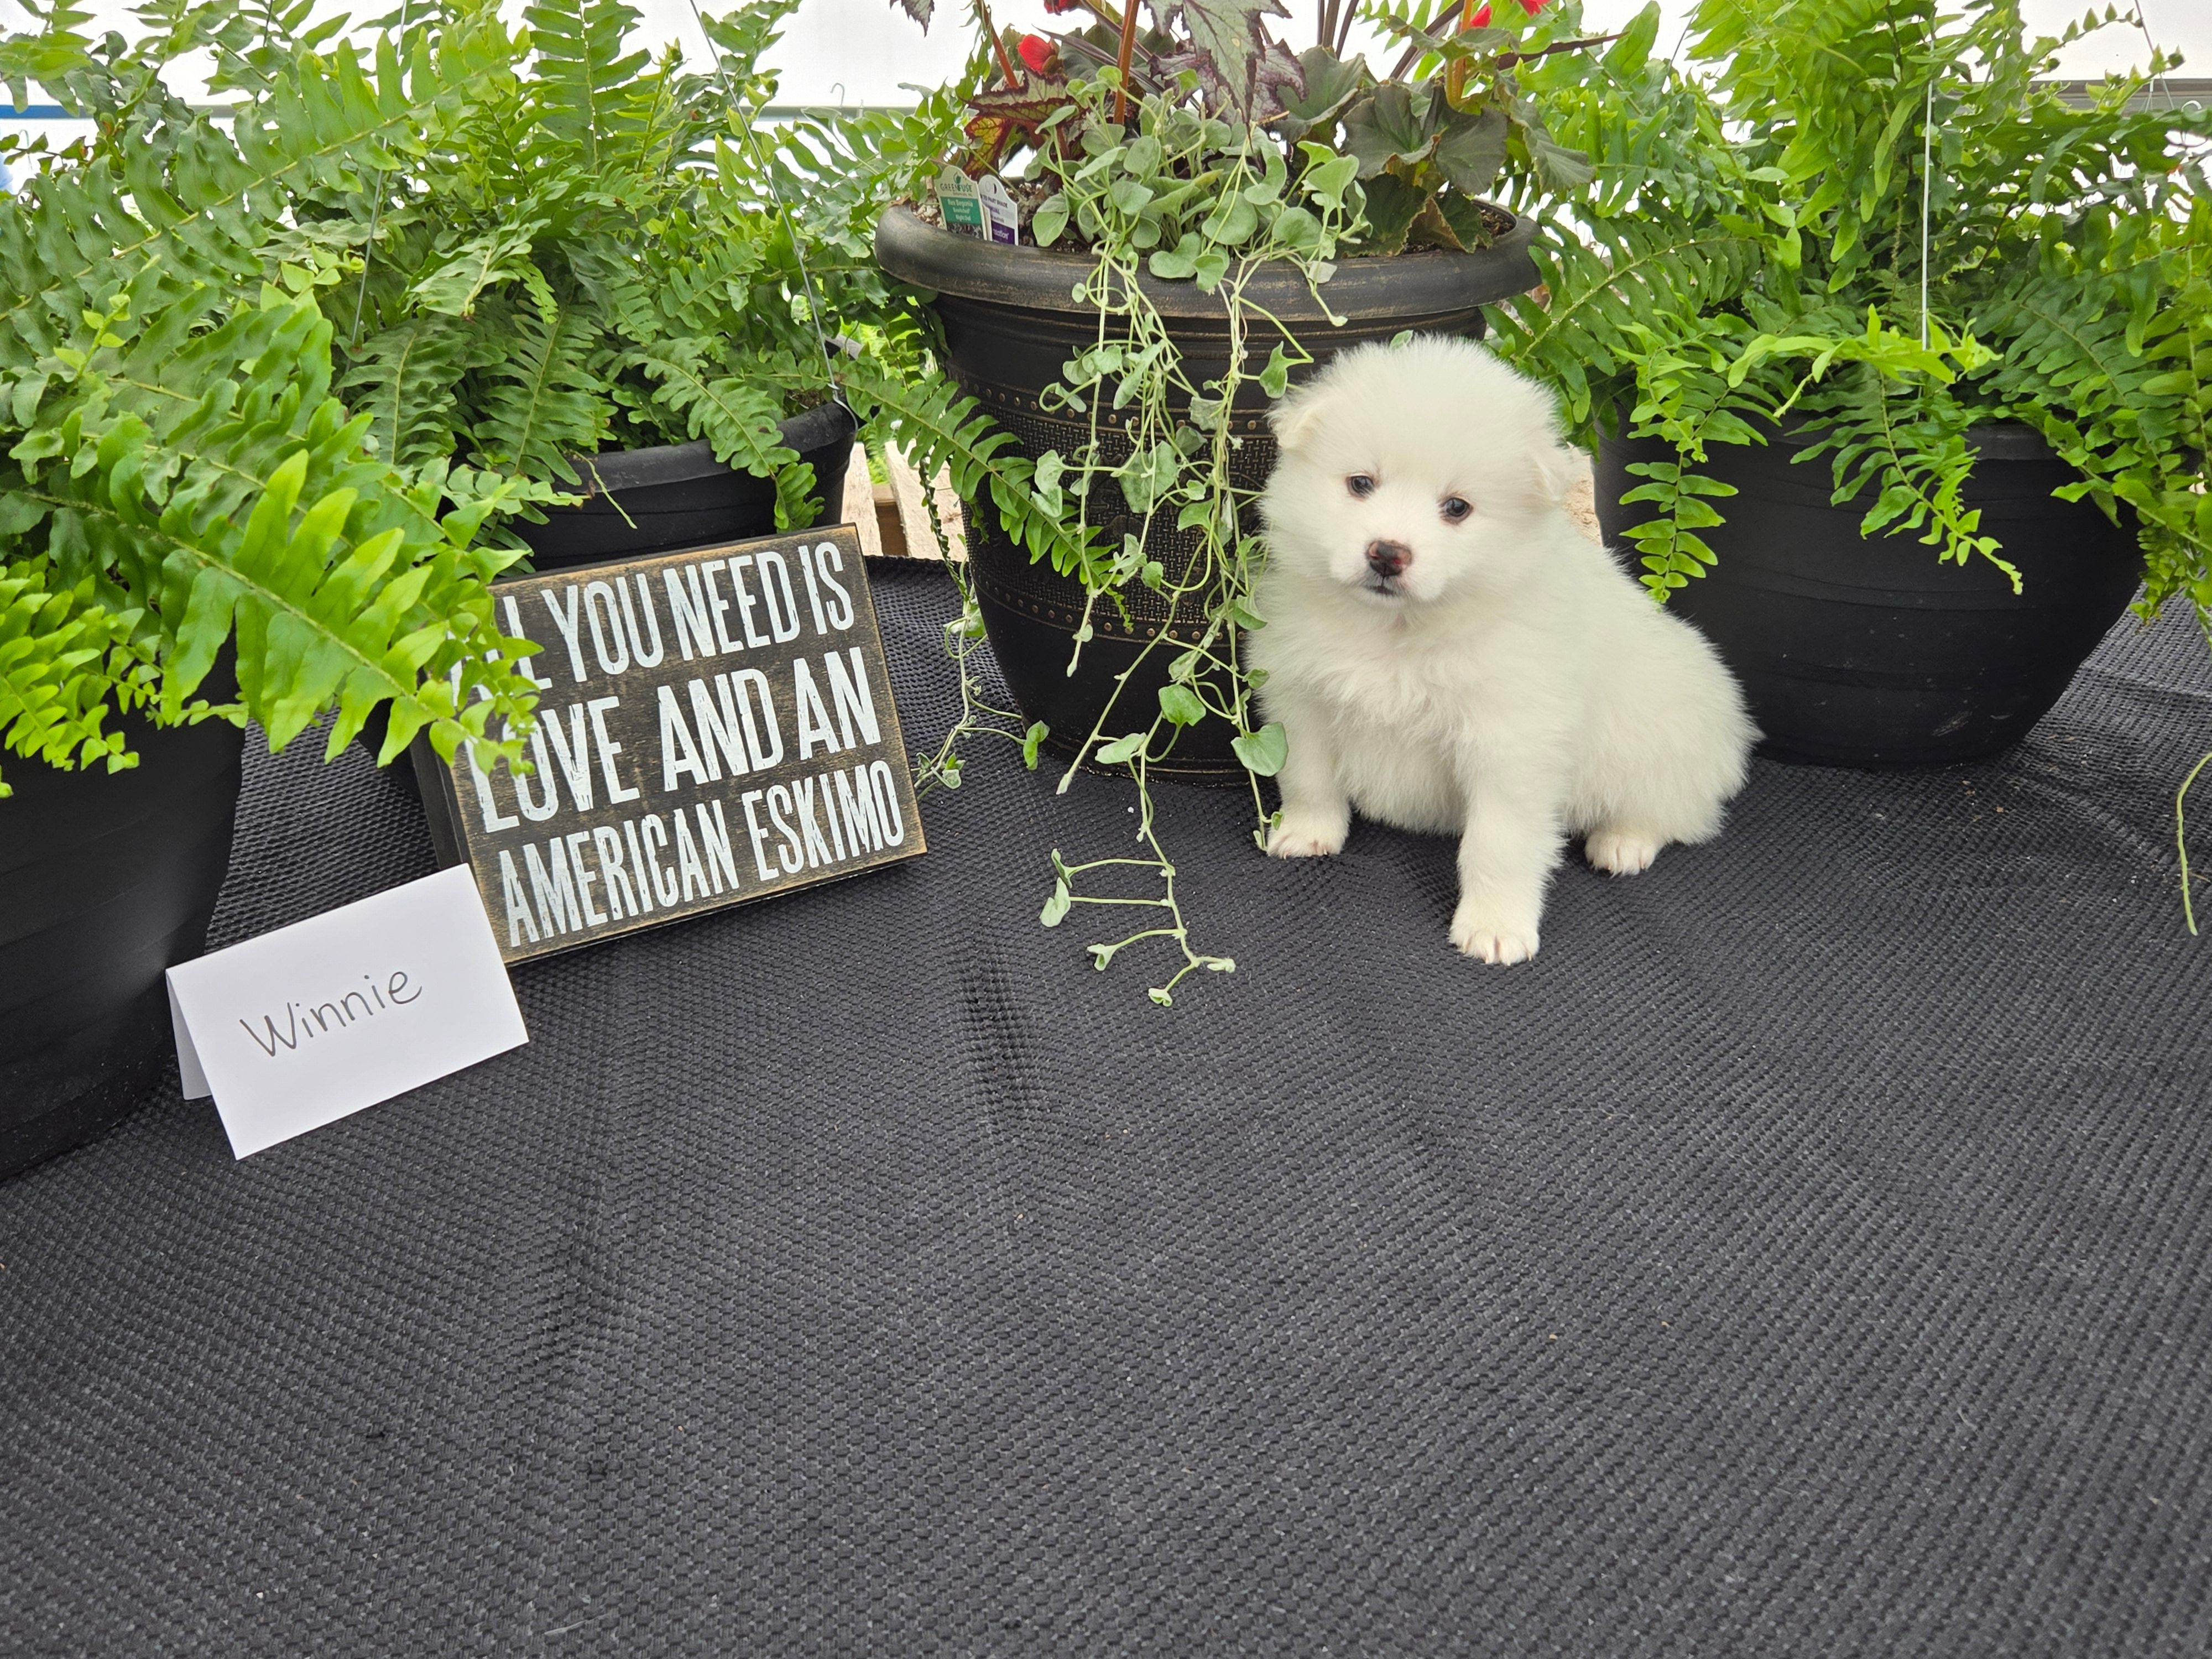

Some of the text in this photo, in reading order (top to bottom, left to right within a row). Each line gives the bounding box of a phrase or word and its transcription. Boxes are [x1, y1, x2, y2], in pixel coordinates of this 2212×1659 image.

[539, 572, 665, 683] YOU
[662, 550, 801, 662] NEED
[797, 541, 855, 635] IS
[463, 645, 882, 834] LOVE AND AN
[498, 759, 905, 948] AMERICAN ESKIMO
[239, 971, 422, 1057] Winnie
